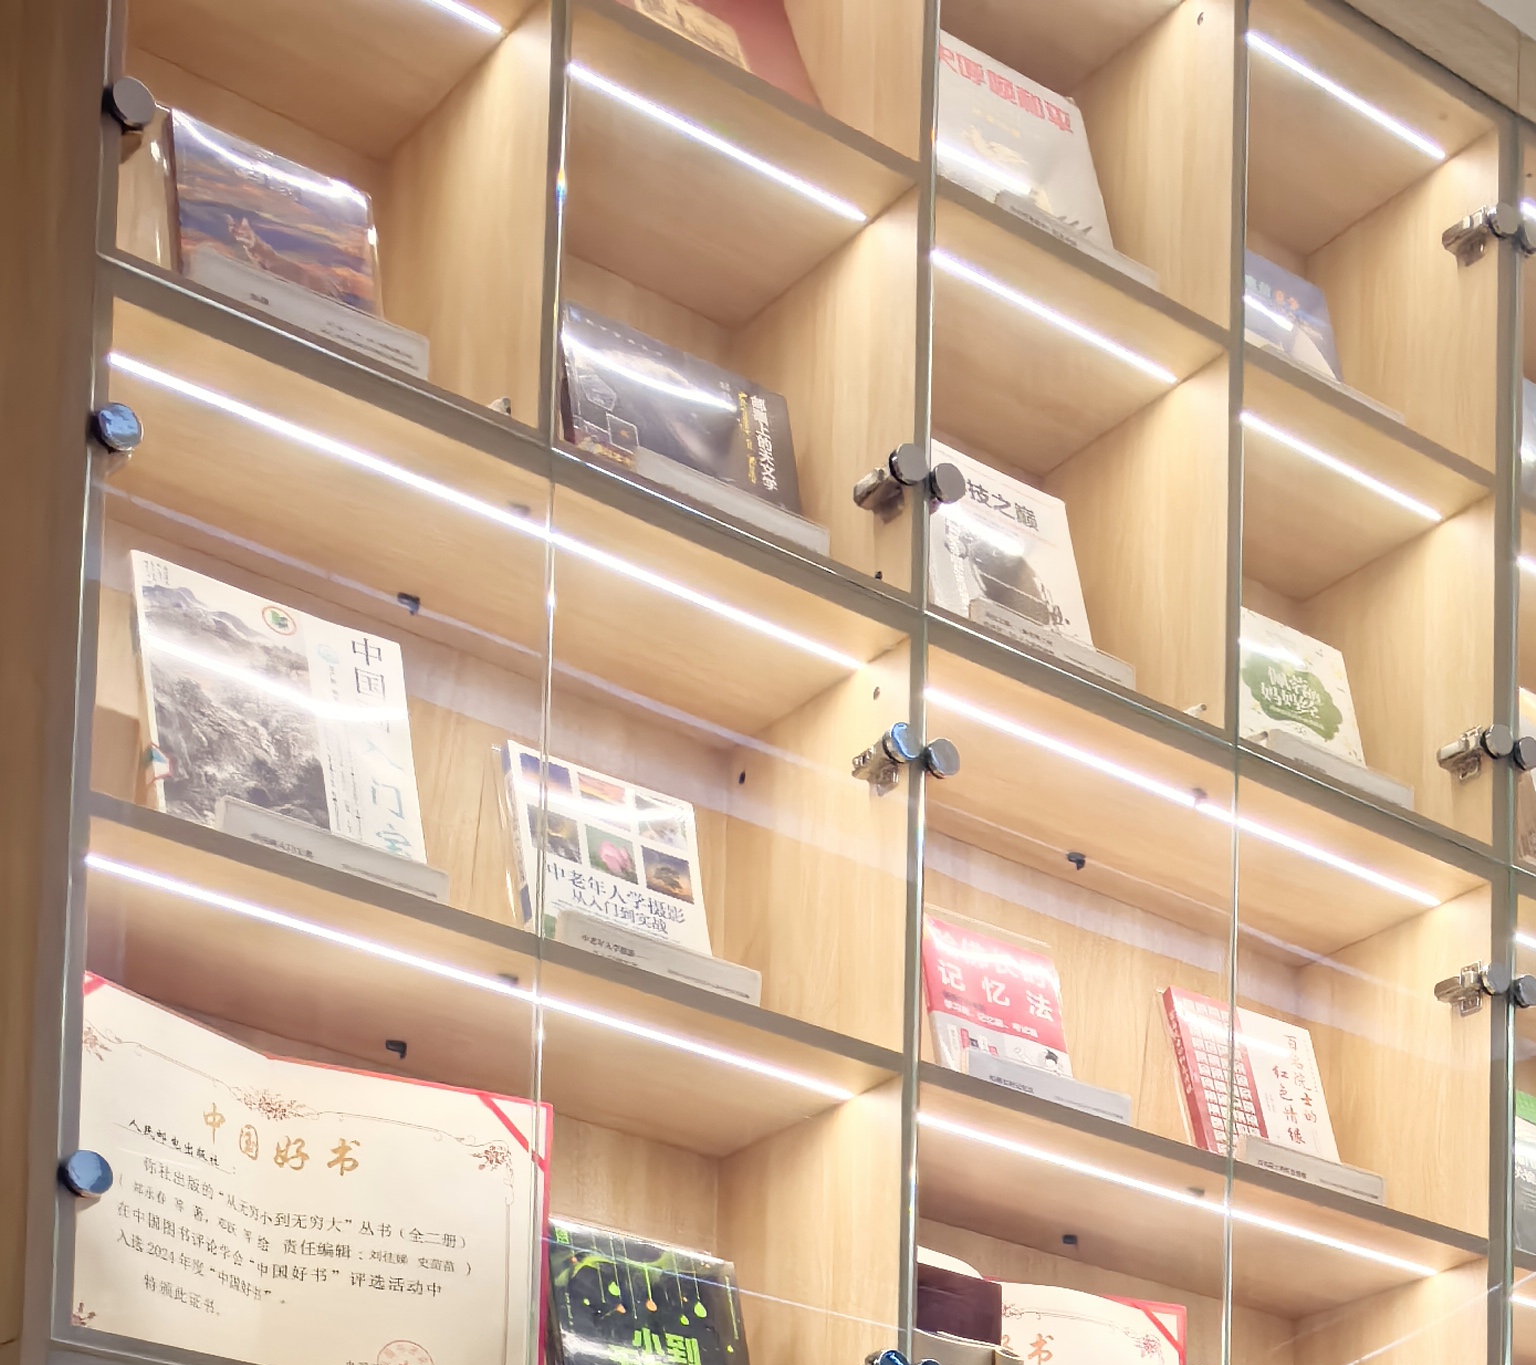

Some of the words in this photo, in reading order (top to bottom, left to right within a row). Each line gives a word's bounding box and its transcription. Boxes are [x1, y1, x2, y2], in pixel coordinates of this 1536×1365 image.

[546, 862, 686, 924] 中老年人学摄影
[572, 889, 668, 935] 从入门到实战
[939, 959, 1055, 1022] 记忆法
[202, 1102, 361, 1176] 中国好书
